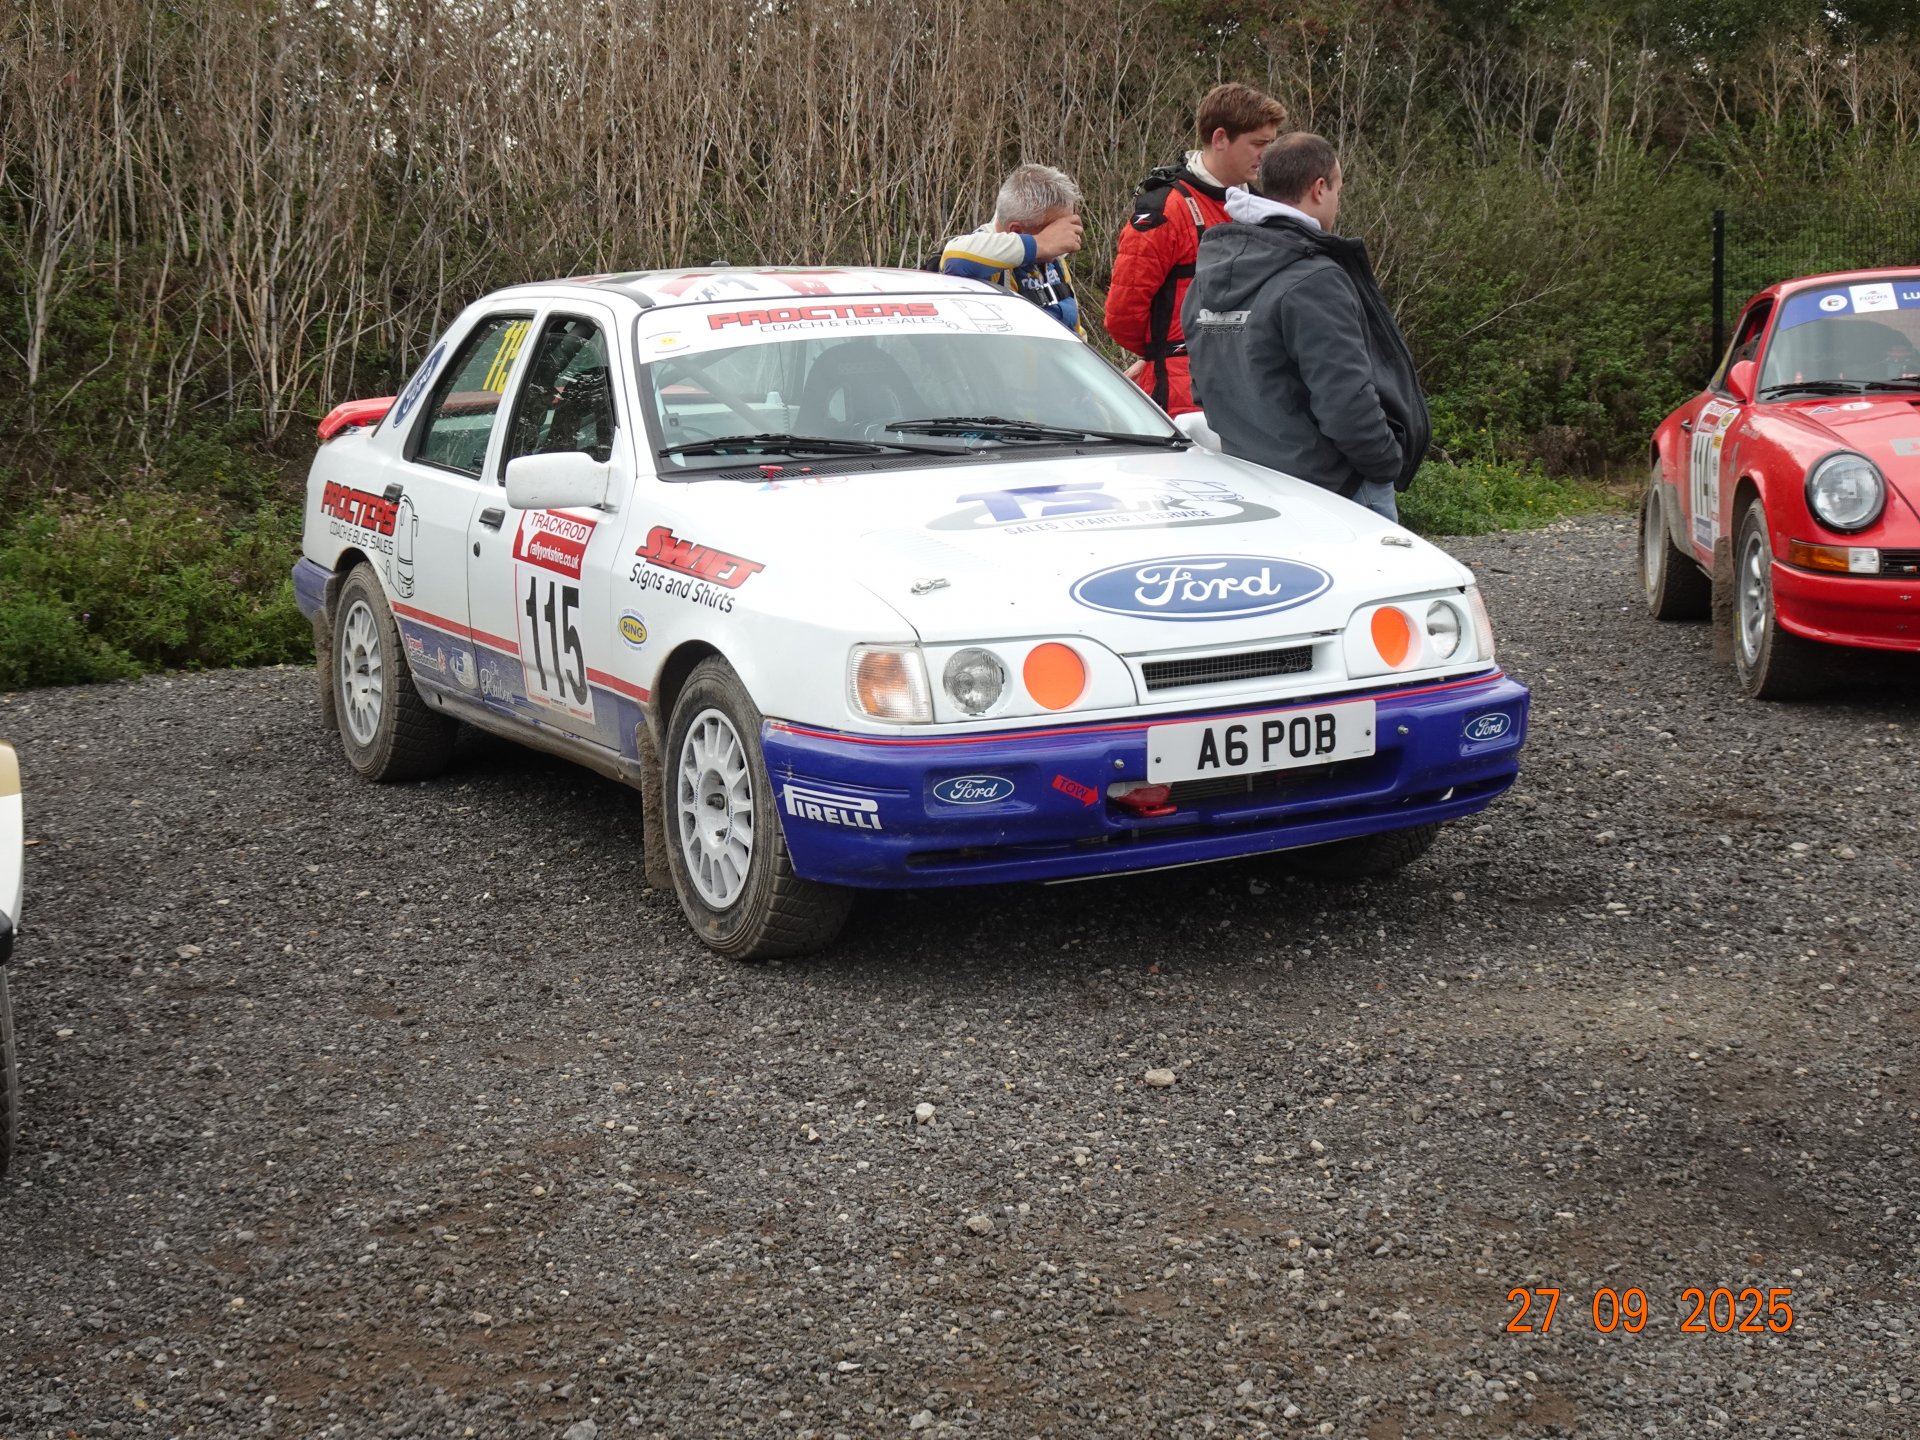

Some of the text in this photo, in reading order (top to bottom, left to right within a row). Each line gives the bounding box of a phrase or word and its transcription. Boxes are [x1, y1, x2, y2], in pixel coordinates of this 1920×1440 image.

[707, 303, 938, 330] PROCTERS
[760, 315, 945, 333] COACH & BUS SALES
[403, 356, 436, 414] Ford
[321, 480, 400, 537] PROCTERS
[1004, 510, 1216, 535] SALES PARTS SERVICE
[531, 512, 587, 541] TRACKROD
[352, 530, 369, 547] BUS
[369, 535, 393, 555] SALES
[529, 541, 580, 570] rallyyorkshire.co.uk
[635, 525, 766, 589] SWIFT
[629, 563, 735, 613] Signs and Shirts
[1135, 562, 1281, 607] Ford
[526, 576, 587, 706] 115
[623, 620, 643, 639] RING
[1474, 715, 1506, 737] Ford
[1197, 713, 1337, 770] A6 POB
[950, 779, 998, 800] Ford
[1060, 779, 1089, 798] TOW
[783, 784, 883, 830] PIRELLI
